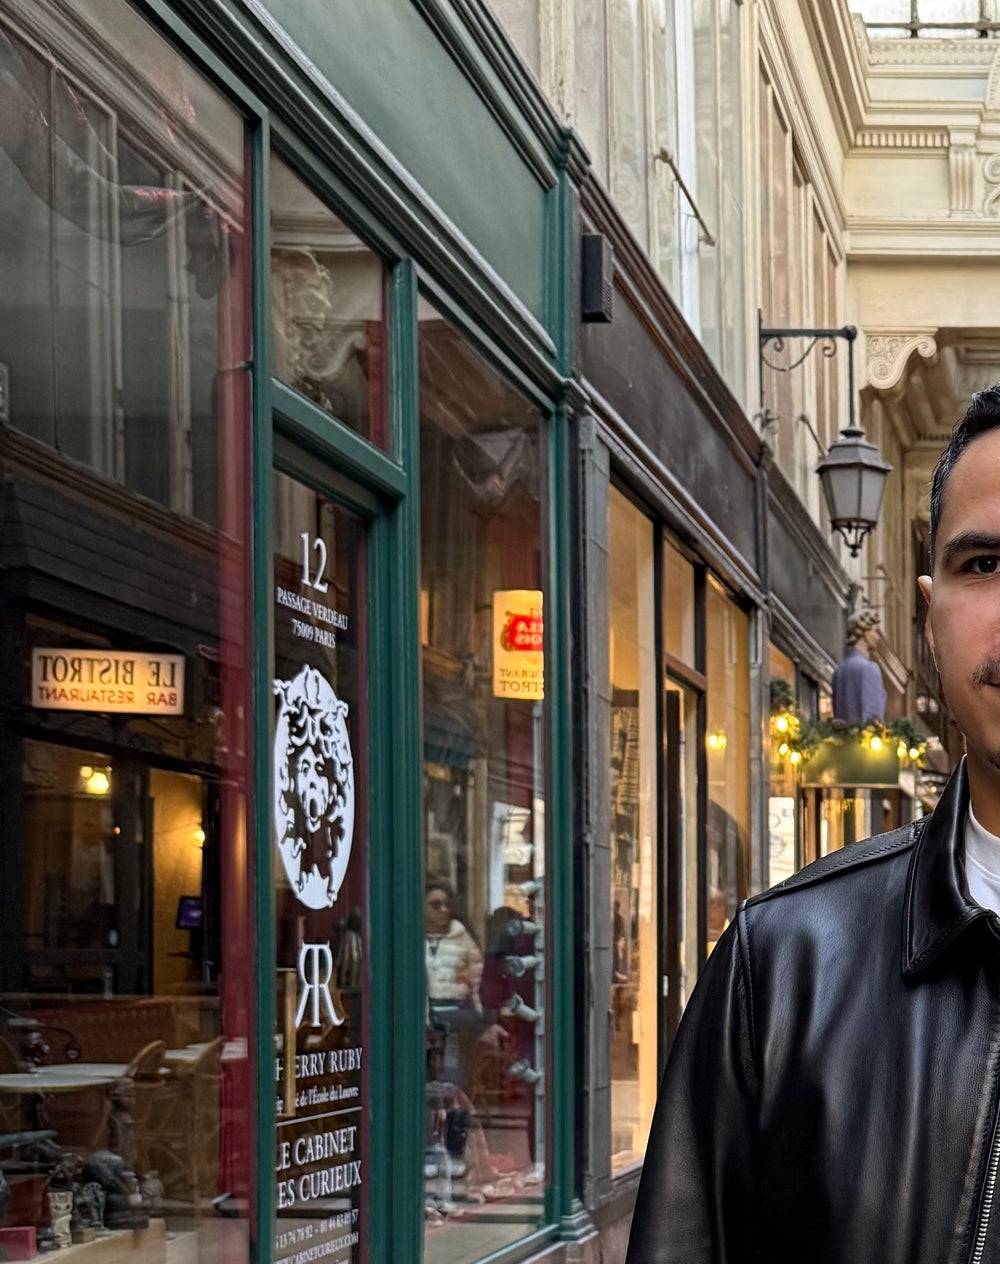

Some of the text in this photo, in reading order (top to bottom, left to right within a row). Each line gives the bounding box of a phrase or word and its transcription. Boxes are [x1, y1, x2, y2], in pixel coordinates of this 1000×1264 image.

[301, 532, 328, 593] 12
[277, 587, 348, 630] PASSAGE VERDEAU
[291, 618, 336, 649] 75009 PARIS
[330, 1047, 363, 1074] RUBY
[338, 1083, 359, 1101] Louvre
[294, 1125, 357, 1166] CABINET
[299, 1160, 362, 1202] CURIEUX
